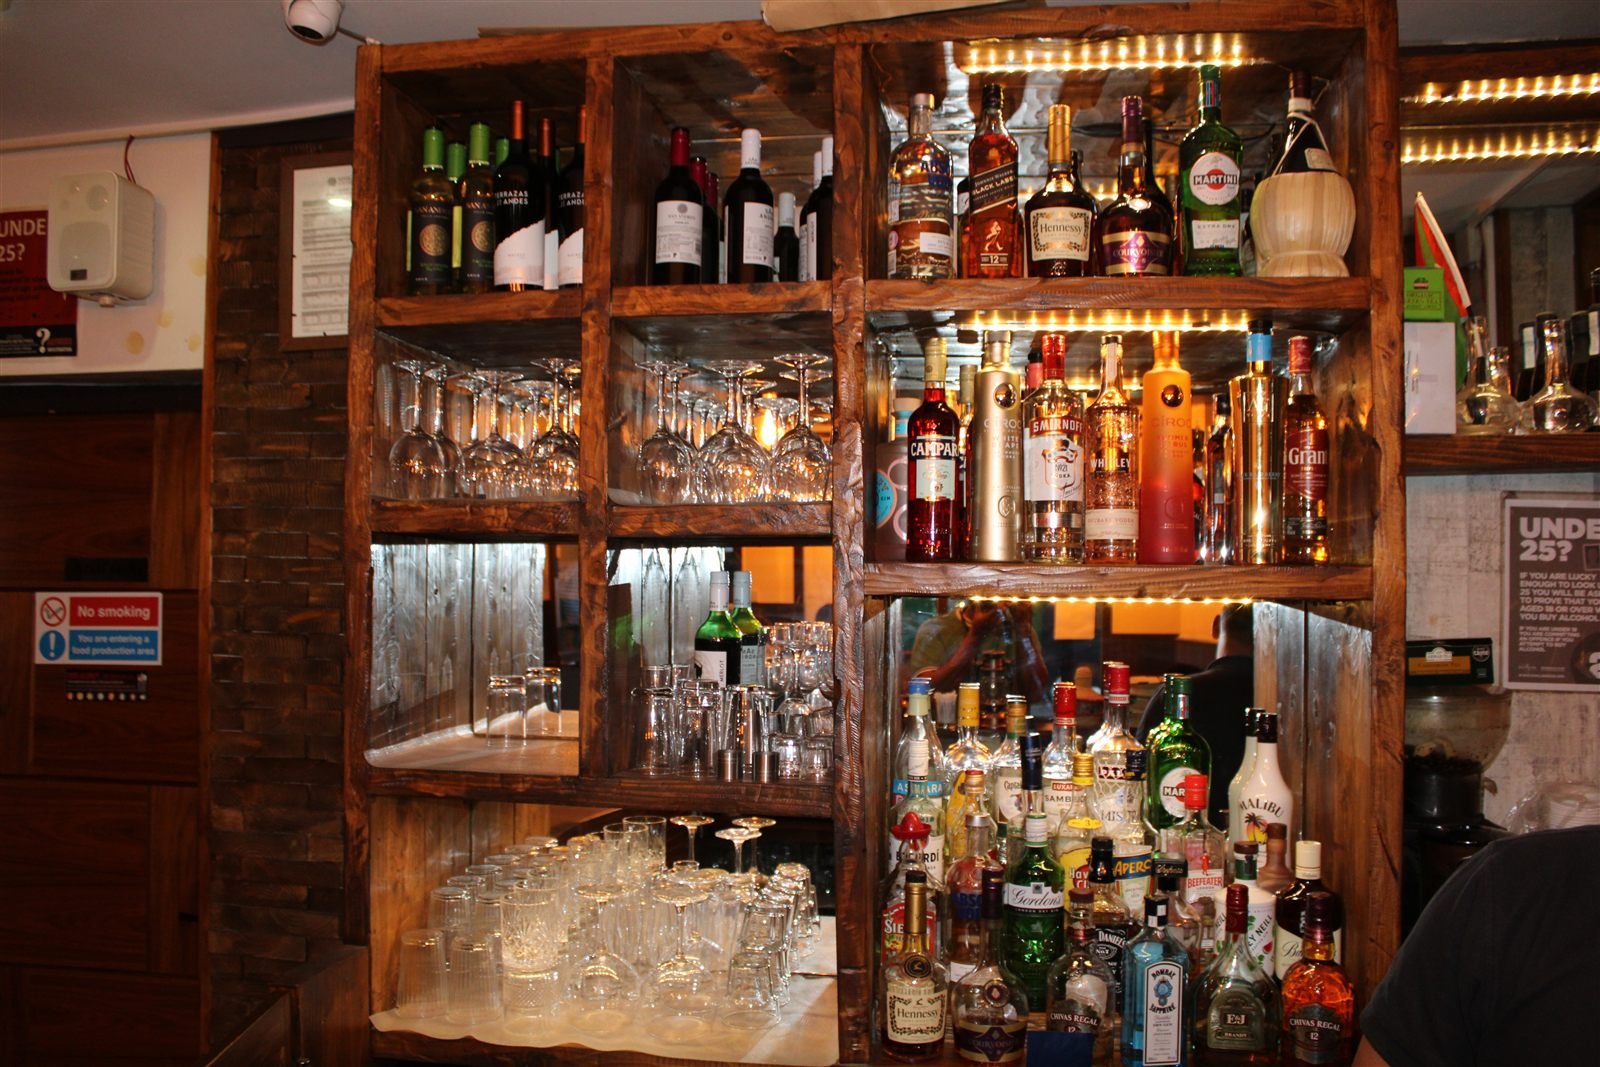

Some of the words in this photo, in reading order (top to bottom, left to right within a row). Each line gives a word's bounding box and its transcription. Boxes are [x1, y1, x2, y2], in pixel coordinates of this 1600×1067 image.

[1194, 175, 1238, 185] MARTINI
[972, 182, 995, 196] BLACK
[1040, 223, 1083, 235] Hennessy
[989, 255, 1000, 264] 12
[1033, 419, 1083, 433] SMIRNOFF
[1519, 539, 1573, 562] 25?
[1529, 572, 1549, 580] YOU
[1551, 589, 1573, 597] WILL
[1533, 597, 1563, 605] PROVE
[78, 606, 95, 618] No
[97, 605, 151, 621] smoking
[1519, 605, 1544, 613] AGED
[1569, 606, 1594, 614] OVER
[1519, 613, 1538, 621] YOU
[1539, 613, 1557, 621] BUY
[78, 634, 93, 643] You
[94, 635, 108, 643] are
[108, 634, 143, 645] entering
[71, 646, 91, 655] food
[91, 646, 135, 656] production
[136, 647, 156, 656] area
[1164, 787, 1185, 796] MAR
[1187, 876, 1223, 888] BEEFEATER
[1012, 888, 1061, 906] Gordon's
[1255, 914, 1272, 937] NEILL
[1151, 968, 1176, 979] BOMBAY
[896, 1007, 938, 1018] Hennessy
[1149, 1003, 1176, 1014] SAPPHIRE
[1050, 1012, 1072, 1021] CHIVAS
[1073, 1014, 1098, 1026] REGAL
[1226, 1013, 1246, 1025] E&J
[1289, 1018, 1315, 1027] CHIVAS
[1316, 1020, 1341, 1032] REGAL
[1310, 1032, 1319, 1040] 12
